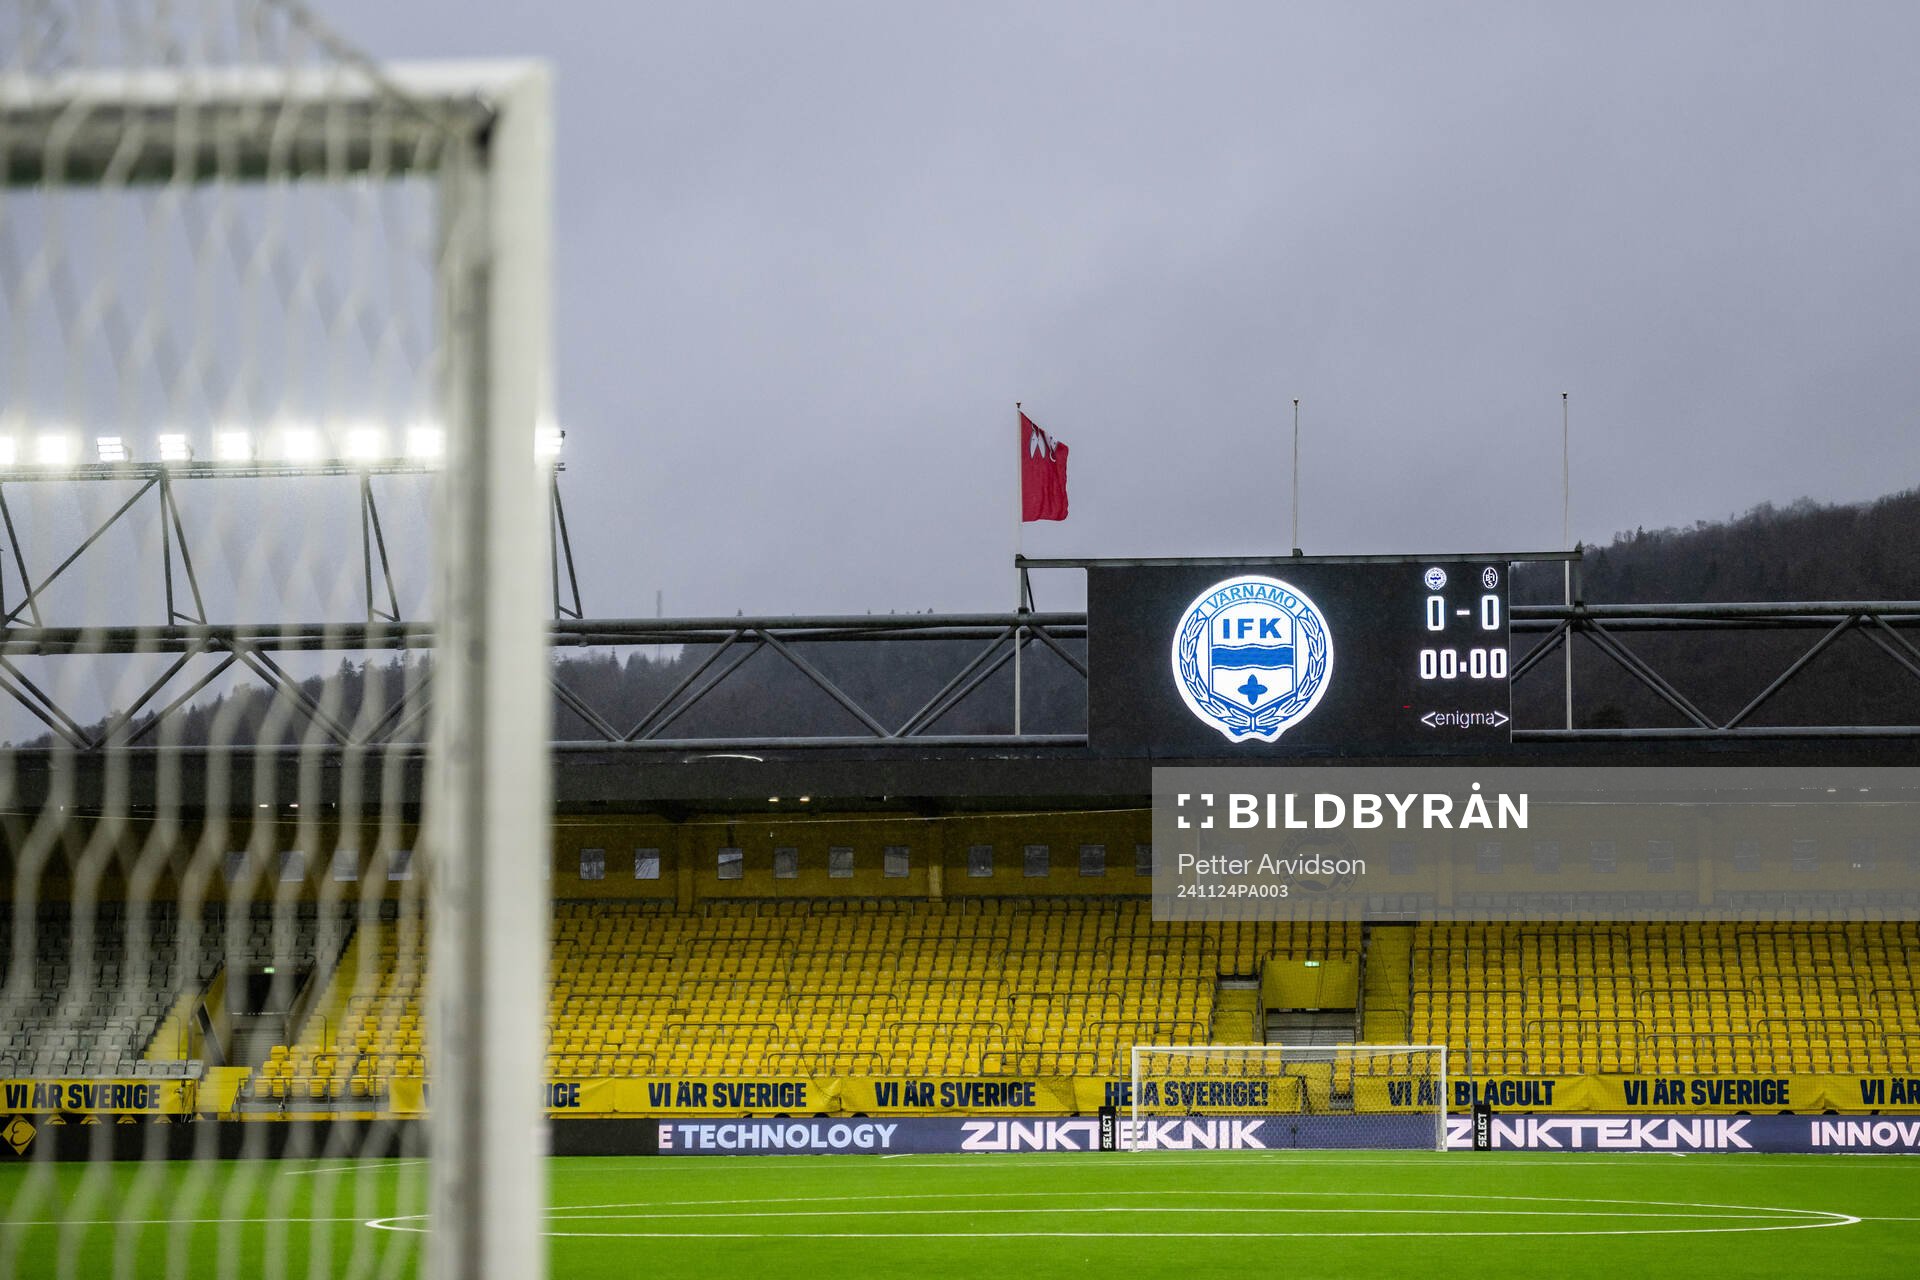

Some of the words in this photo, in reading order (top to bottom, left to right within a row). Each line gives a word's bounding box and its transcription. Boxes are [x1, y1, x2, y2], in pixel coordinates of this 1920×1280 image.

[1206, 584, 1298, 610] VÄRNAMO
[1427, 595, 1445, 631] 0
[1482, 594, 1500, 631] 0
[1222, 617, 1282, 639] IFK
[6, 1084, 28, 1109] VI
[32, 1082, 63, 1109] ÄR
[68, 1084, 161, 1109] SVERIGE
[648, 1082, 671, 1107] VI
[676, 1080, 708, 1107] ÄR
[712, 1082, 807, 1108] SVERIGE
[875, 1081, 899, 1107] VI
[903, 1080, 935, 1107] ÄR
[940, 1081, 1037, 1107] SVERIGE
[1164, 1080, 1269, 1107] SVERIGE!
[1388, 1080, 1412, 1106] VI
[1454, 1079, 1556, 1106] BLÅGULT
[1623, 1079, 1648, 1105] VI
[1653, 1078, 1686, 1105] ÄR
[1691, 1079, 1790, 1106] SVERIGE
[1860, 1079, 1885, 1105] VI
[1890, 1077, 1920, 1105] ÄR
[678, 1124, 898, 1149] TECHNOLOGY
[1102, 1114, 1112, 1149] SELECT
[1447, 1118, 1752, 1149] ZNKTEKNIK
[1477, 1112, 1487, 1147] SELECT
[1811, 1121, 1920, 1147] INNOV
